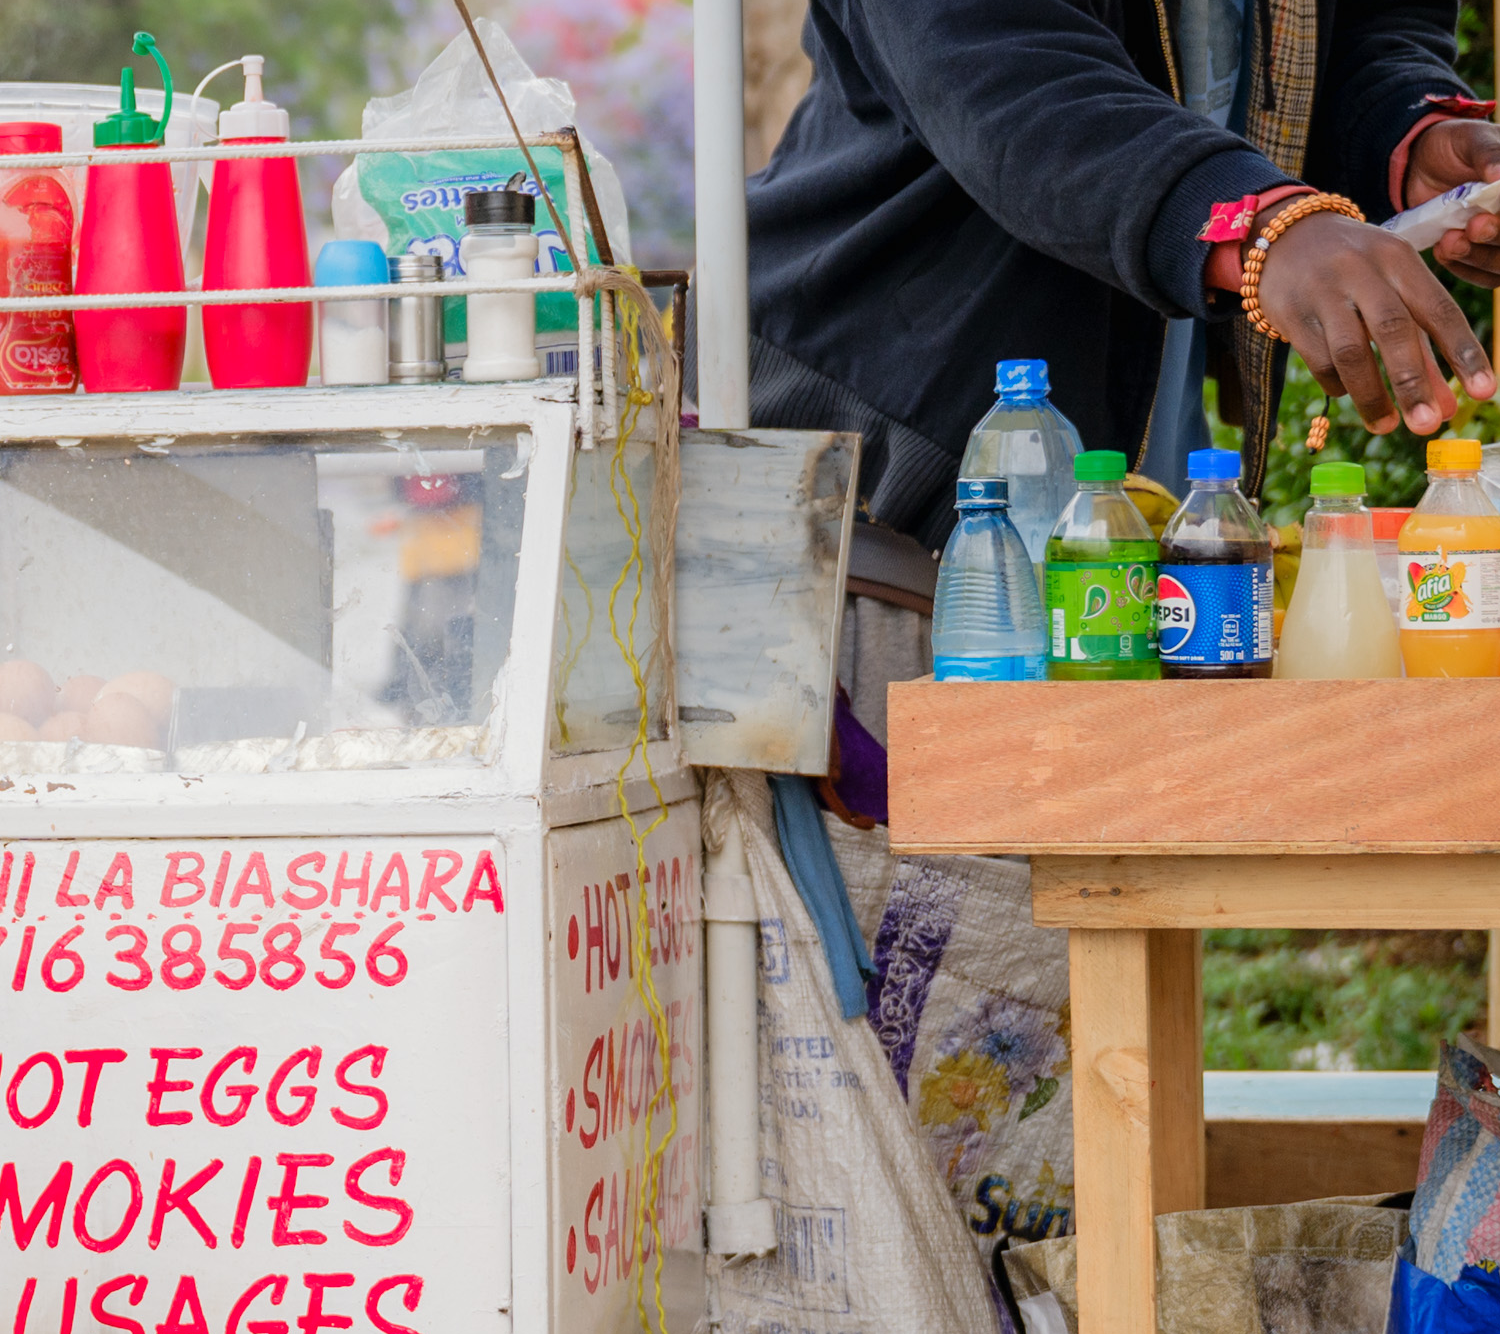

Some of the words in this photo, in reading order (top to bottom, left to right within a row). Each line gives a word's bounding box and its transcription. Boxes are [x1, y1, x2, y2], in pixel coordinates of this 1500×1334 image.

[14, 345, 70, 368] zesta
[1417, 574, 1451, 602] afia
[1220, 650, 1234, 661] 500
[55, 850, 136, 911] LA
[159, 848, 505, 915] BIASHARA
[584, 873, 634, 994] HOT
[146, 1044, 390, 1131] EGGS
